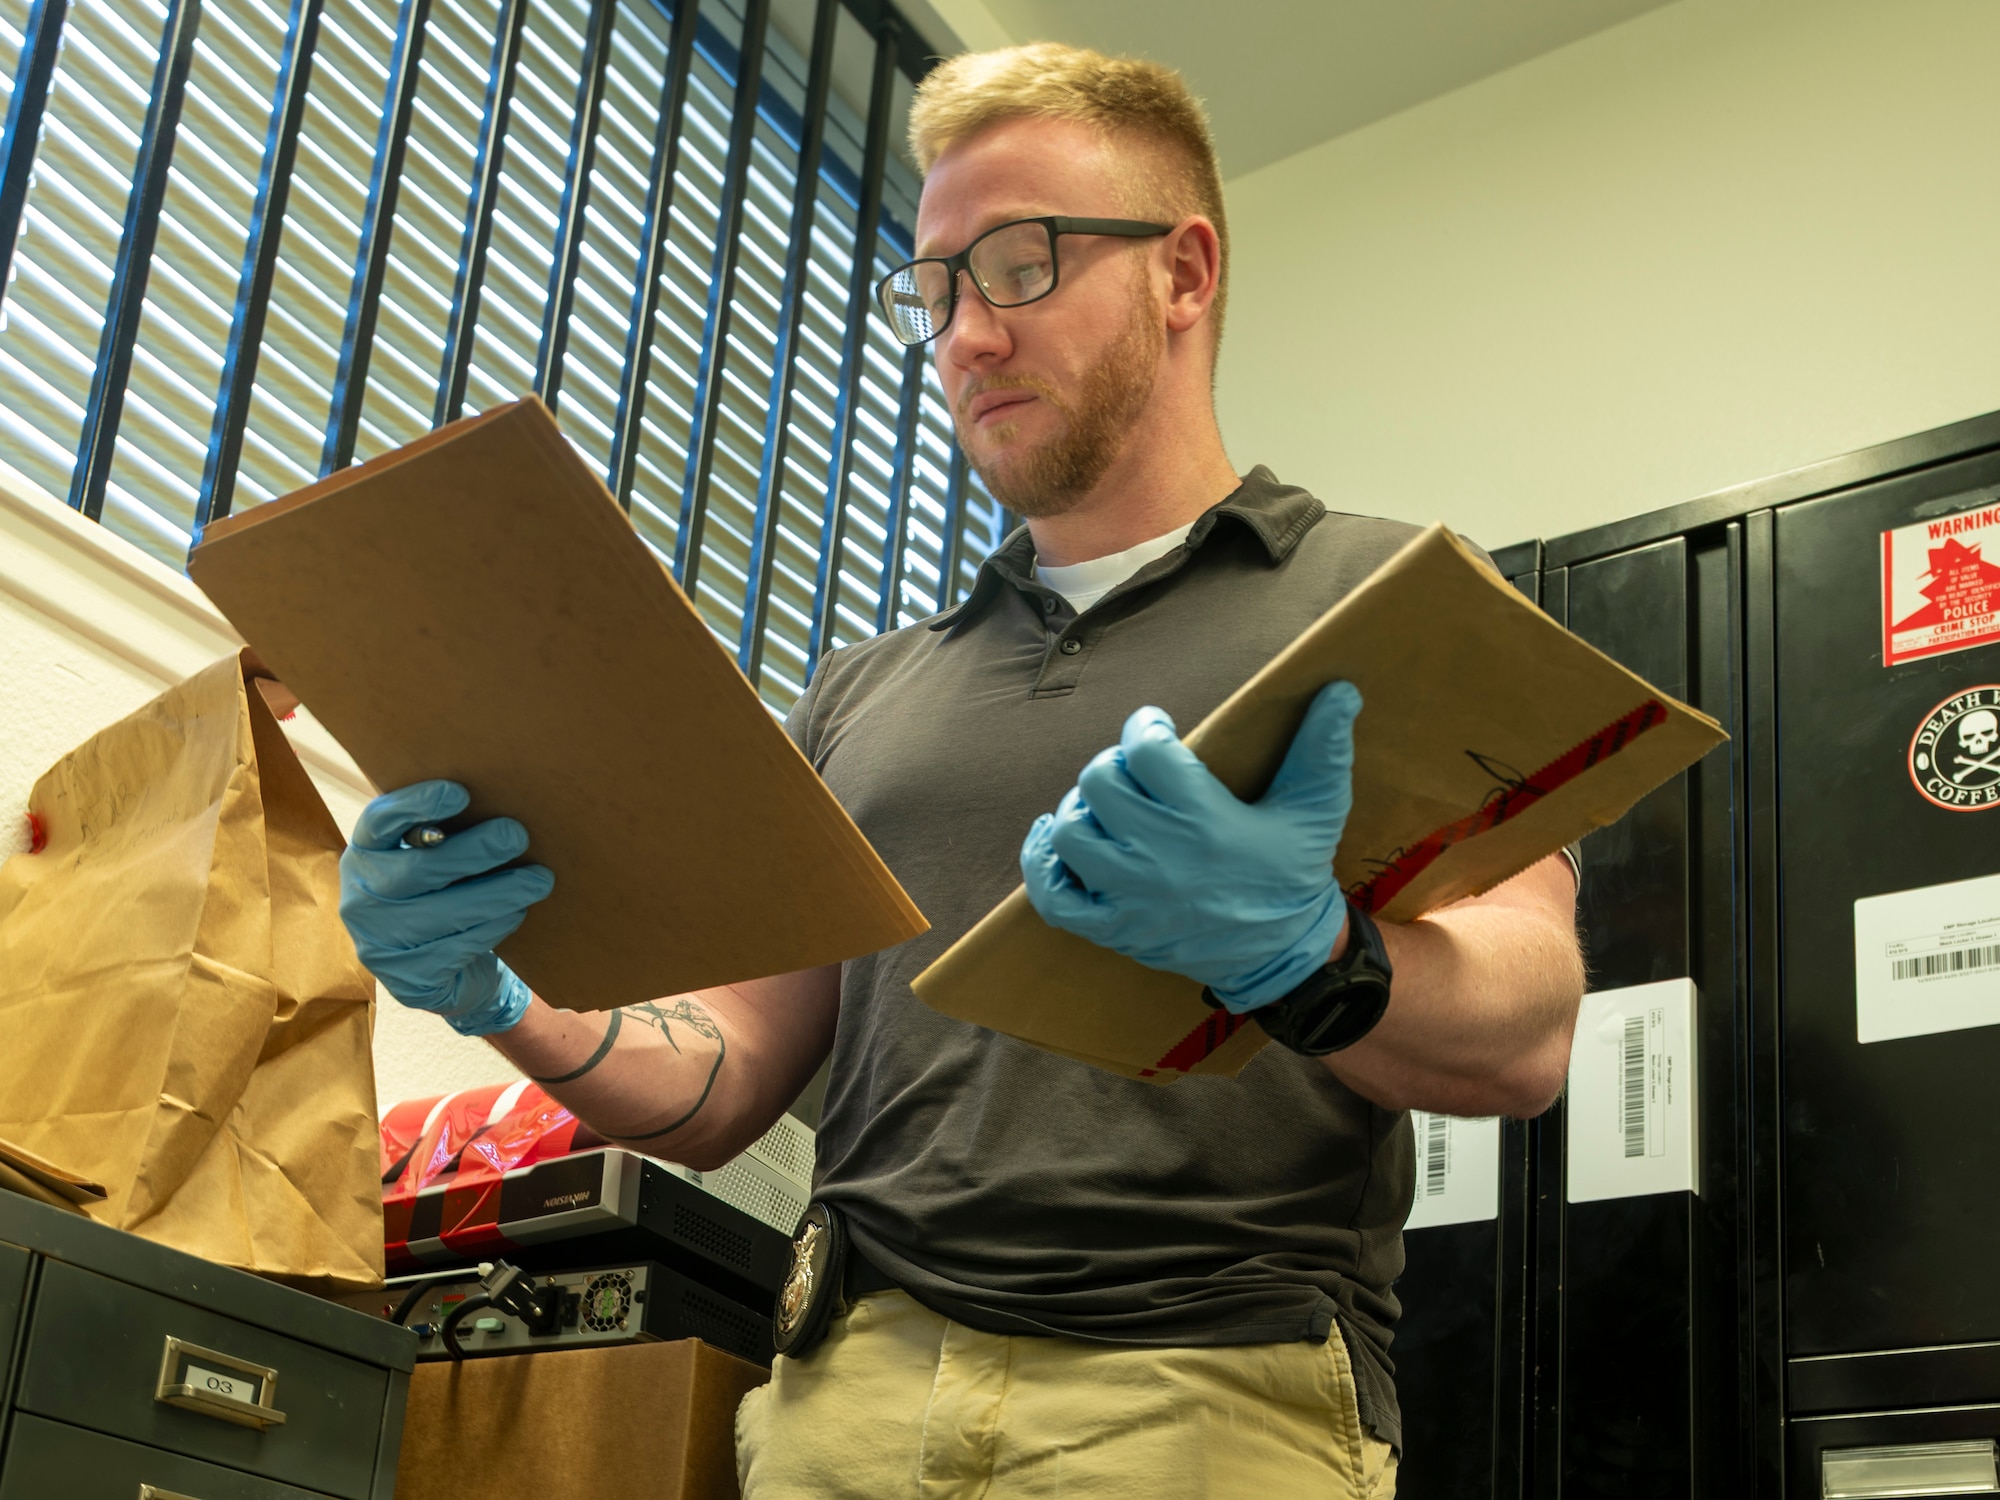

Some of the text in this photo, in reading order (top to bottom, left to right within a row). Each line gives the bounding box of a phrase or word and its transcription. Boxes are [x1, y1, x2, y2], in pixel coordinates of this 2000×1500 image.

[1943, 599, 1989, 621] POLICE
[1933, 614, 1996, 636] CRIME STOP
[1928, 630, 1976, 645] PARTICIPATION
[1918, 692, 1981, 746] DEATH
[1926, 778, 2000, 805] COFFE
[206, 1376, 233, 1394] 03
